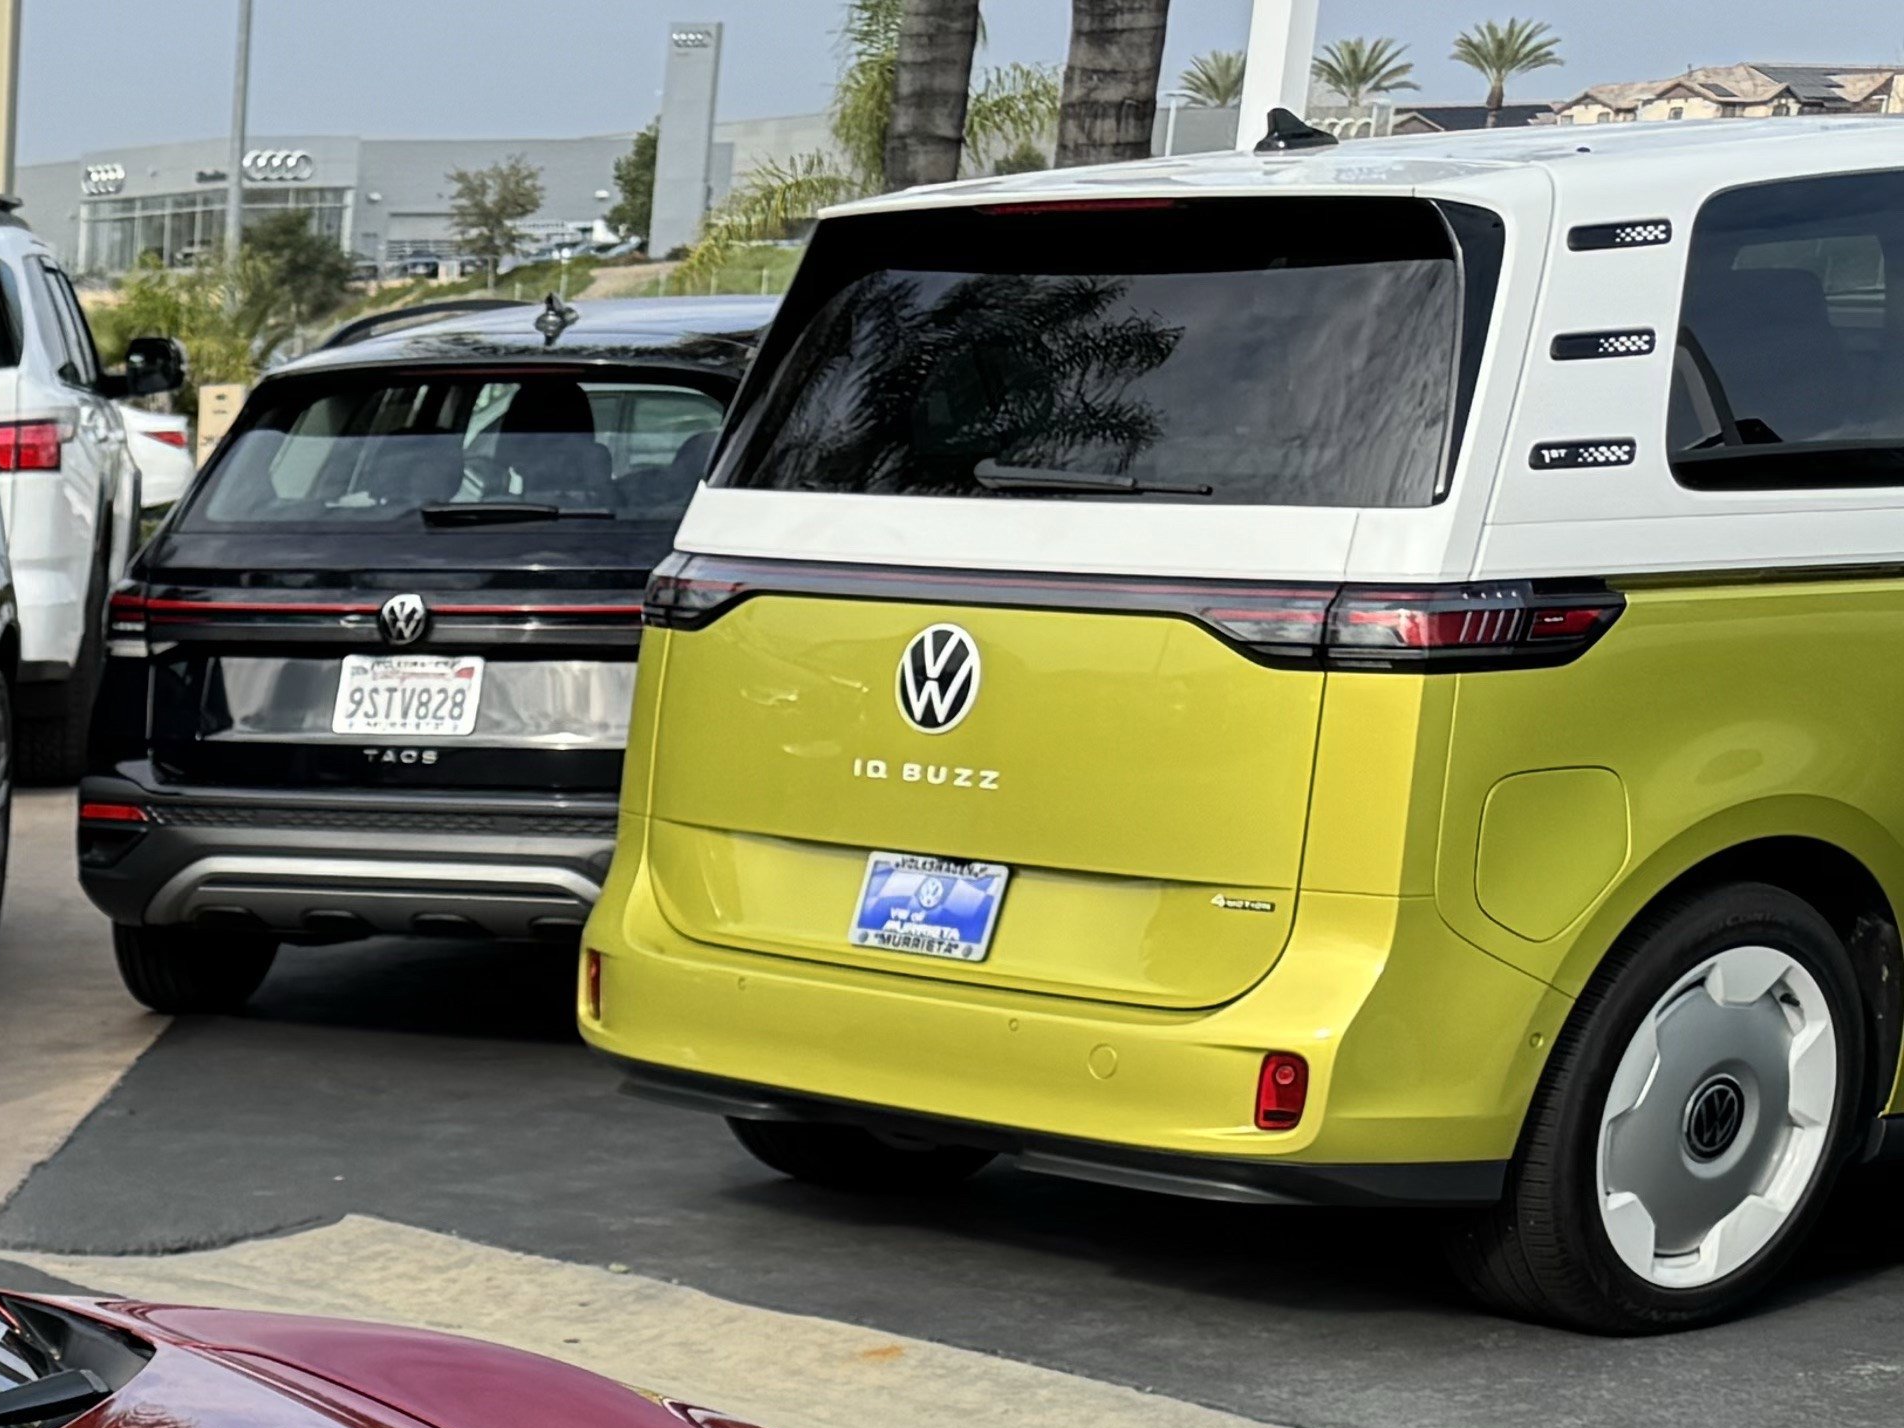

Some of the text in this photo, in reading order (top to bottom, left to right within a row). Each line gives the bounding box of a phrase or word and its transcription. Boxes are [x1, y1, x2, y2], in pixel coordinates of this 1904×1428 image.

[894, 622, 982, 736] VW
[344, 686, 468, 721] 9STV828
[363, 749, 439, 765] TAOS
[902, 763, 1000, 790] BUZZ
